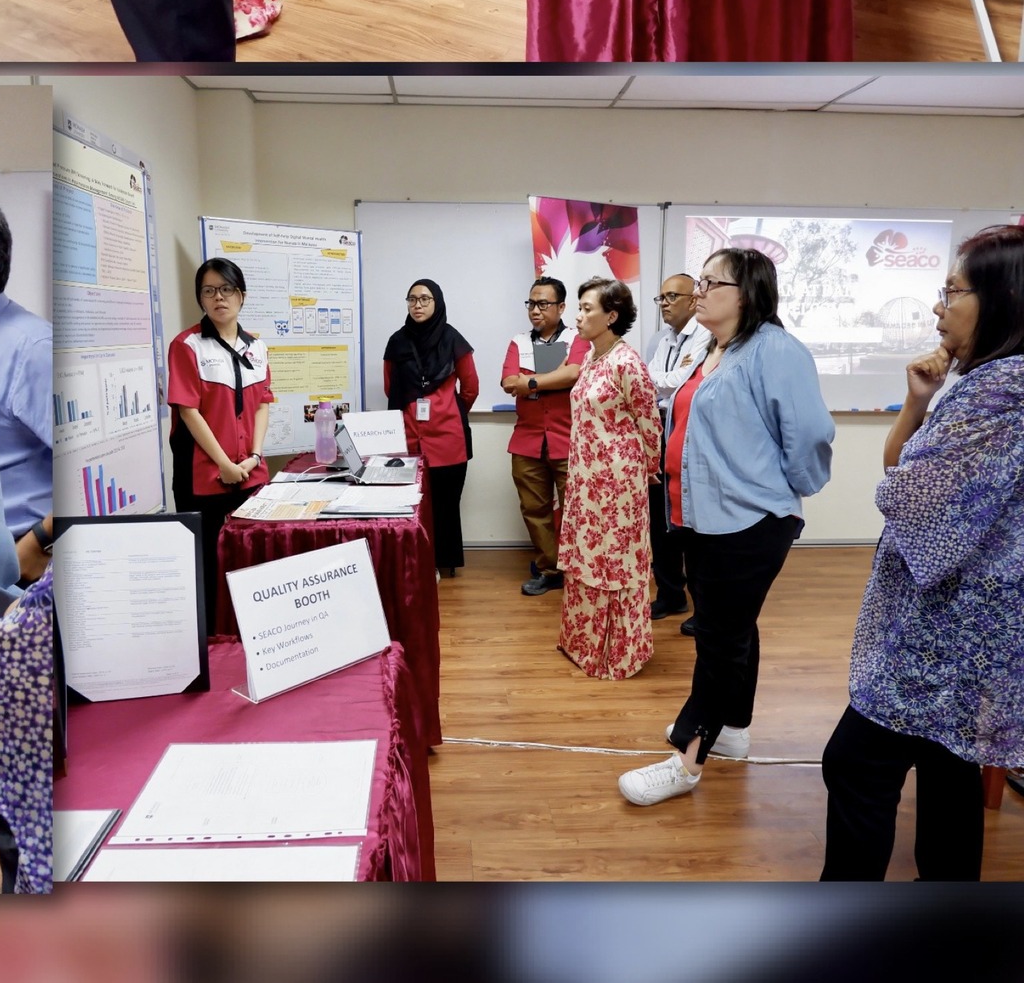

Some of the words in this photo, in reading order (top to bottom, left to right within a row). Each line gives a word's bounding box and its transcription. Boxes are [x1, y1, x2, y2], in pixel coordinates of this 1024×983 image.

[884, 253, 941, 268] seaco
[252, 580, 299, 603] QUALITY
[302, 563, 358, 589] ASSURANCE
[294, 589, 331, 609] BOOTH
[258, 625, 283, 640] SEACO
[284, 618, 310, 632] Journey
[318, 610, 329, 621] QA
[261, 645, 276, 656] Key
[276, 632, 314, 650] Workflows
[265, 645, 319, 671] Documentation
